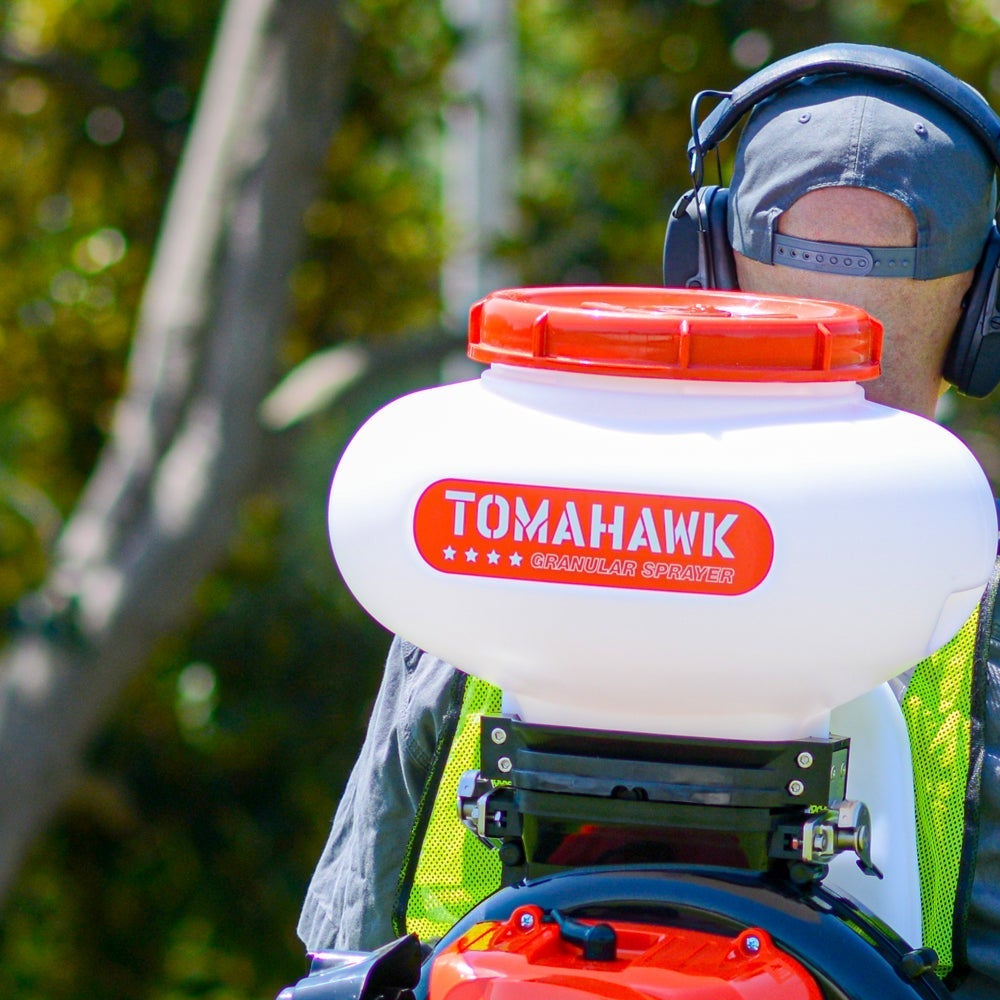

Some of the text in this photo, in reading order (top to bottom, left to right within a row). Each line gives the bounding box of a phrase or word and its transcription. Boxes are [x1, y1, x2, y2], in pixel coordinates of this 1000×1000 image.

[445, 490, 739, 559] TOMAHAWK
[530, 552, 735, 584] GRANULAR SPRAYER
